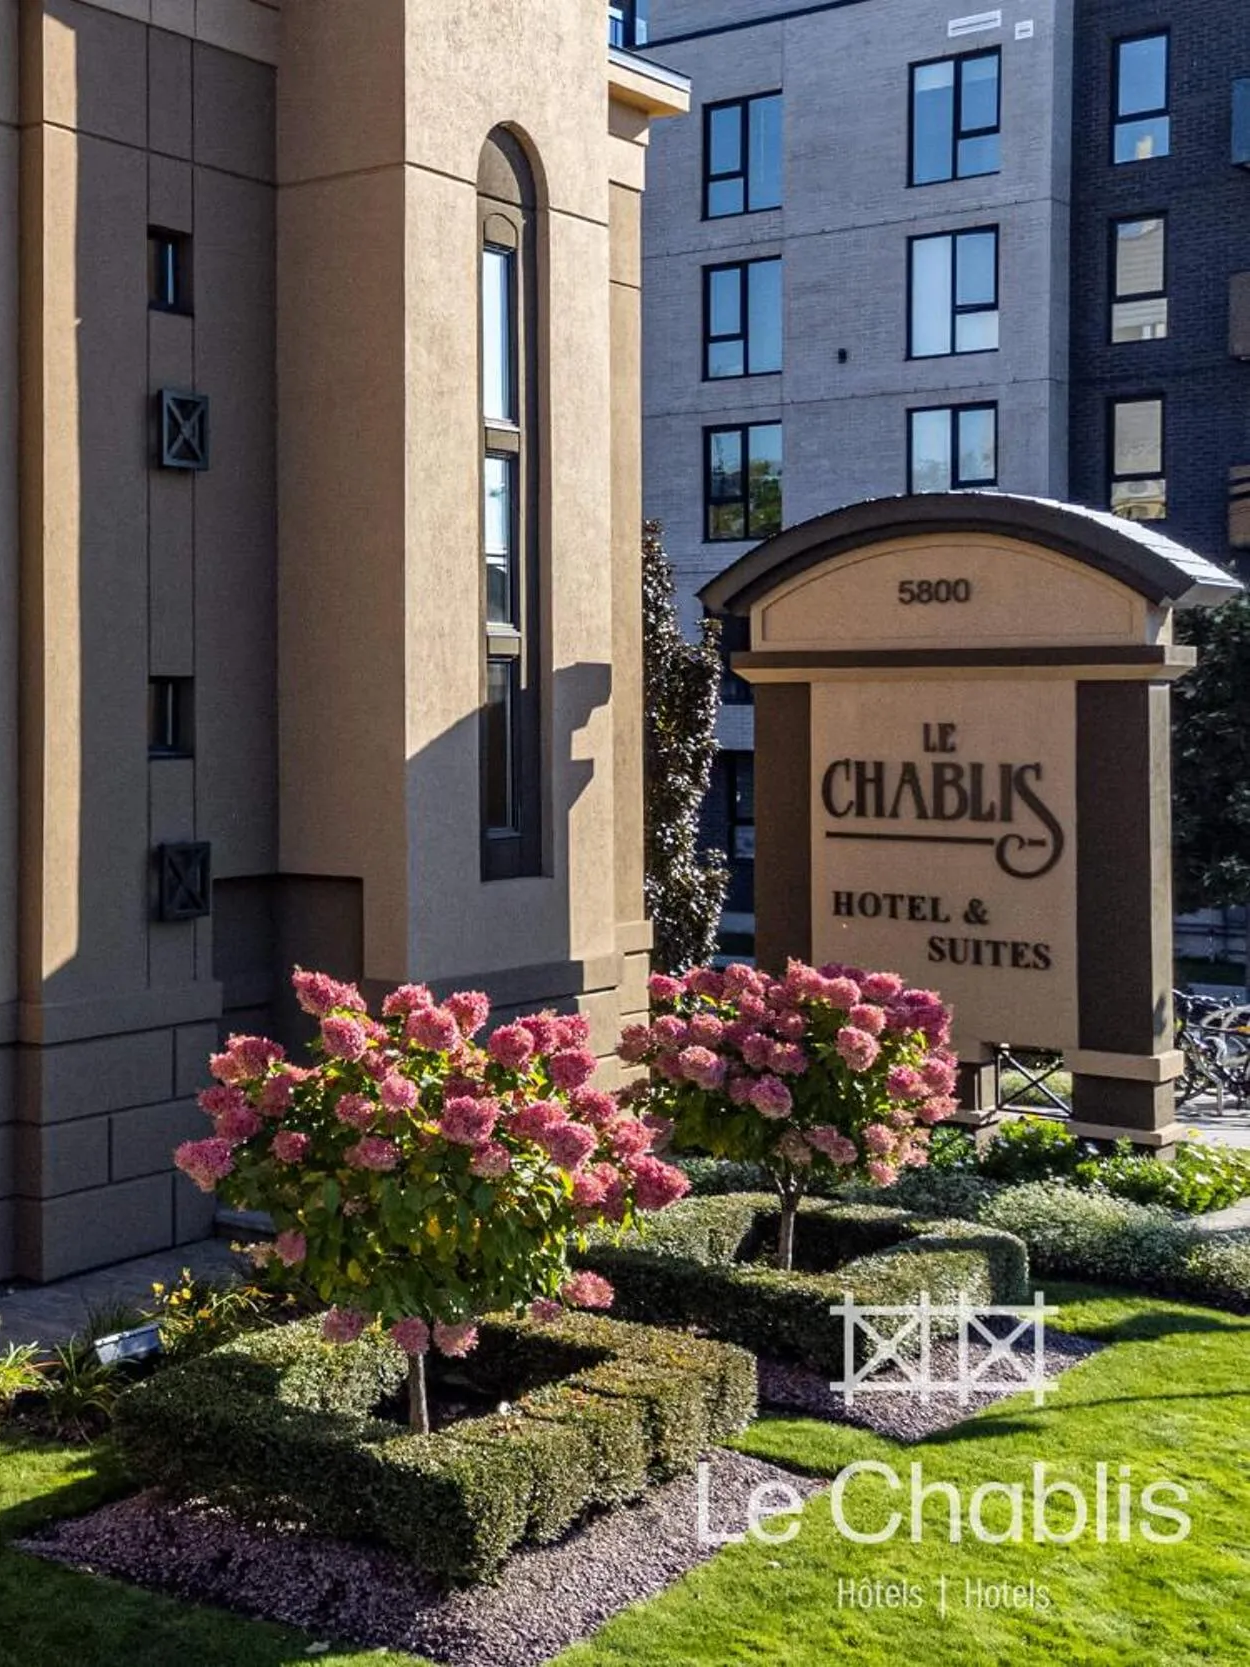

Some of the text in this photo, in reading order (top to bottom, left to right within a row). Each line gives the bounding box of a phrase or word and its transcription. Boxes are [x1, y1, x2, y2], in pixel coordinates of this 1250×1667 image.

[898, 579, 970, 605] 5800
[923, 722, 956, 752] LE
[821, 757, 1064, 880] CHABLIS
[833, 890, 989, 926] HOTEL &
[928, 936, 1050, 970] SUITES
